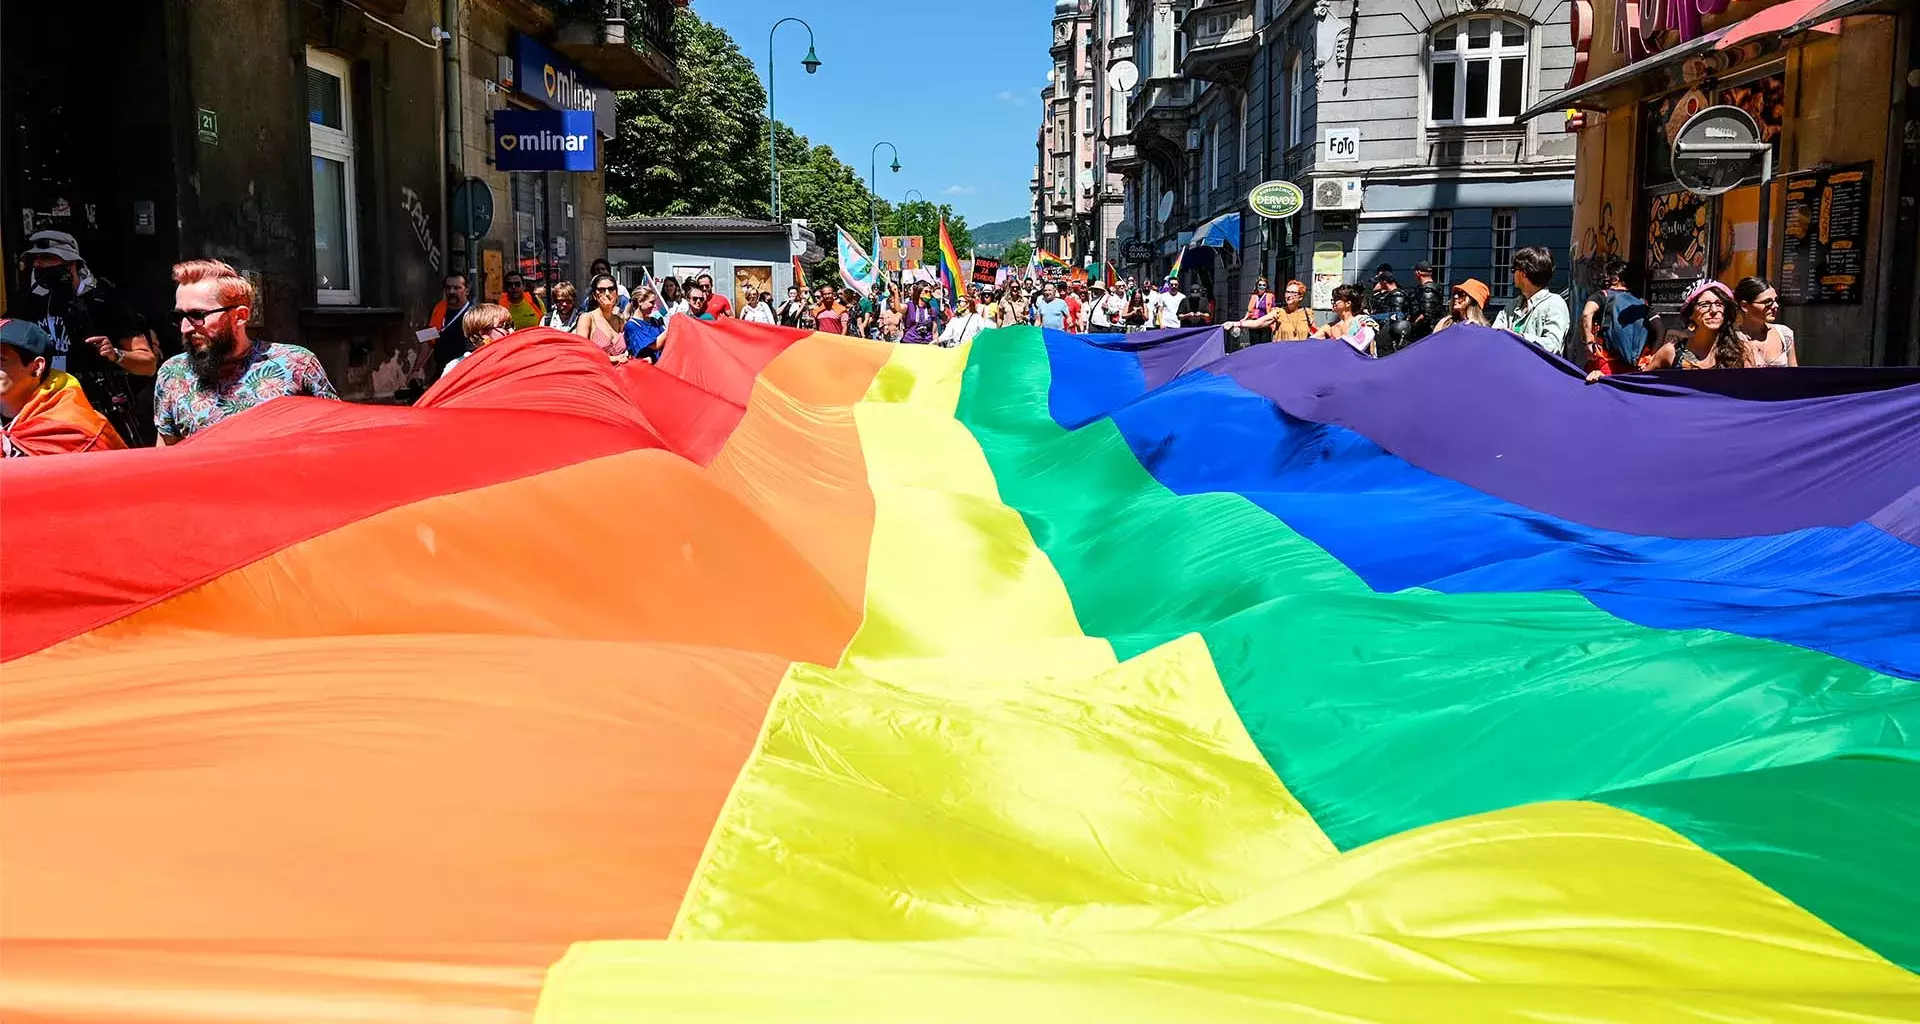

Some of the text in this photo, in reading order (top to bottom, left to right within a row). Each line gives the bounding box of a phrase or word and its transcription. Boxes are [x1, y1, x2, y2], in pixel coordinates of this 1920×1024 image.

[557, 69, 597, 111] mlinar
[203, 115, 213, 128] 21
[519, 130, 589, 151] mlinar
[1329, 137, 1355, 155] FOTO
[898, 247, 908, 259] U
